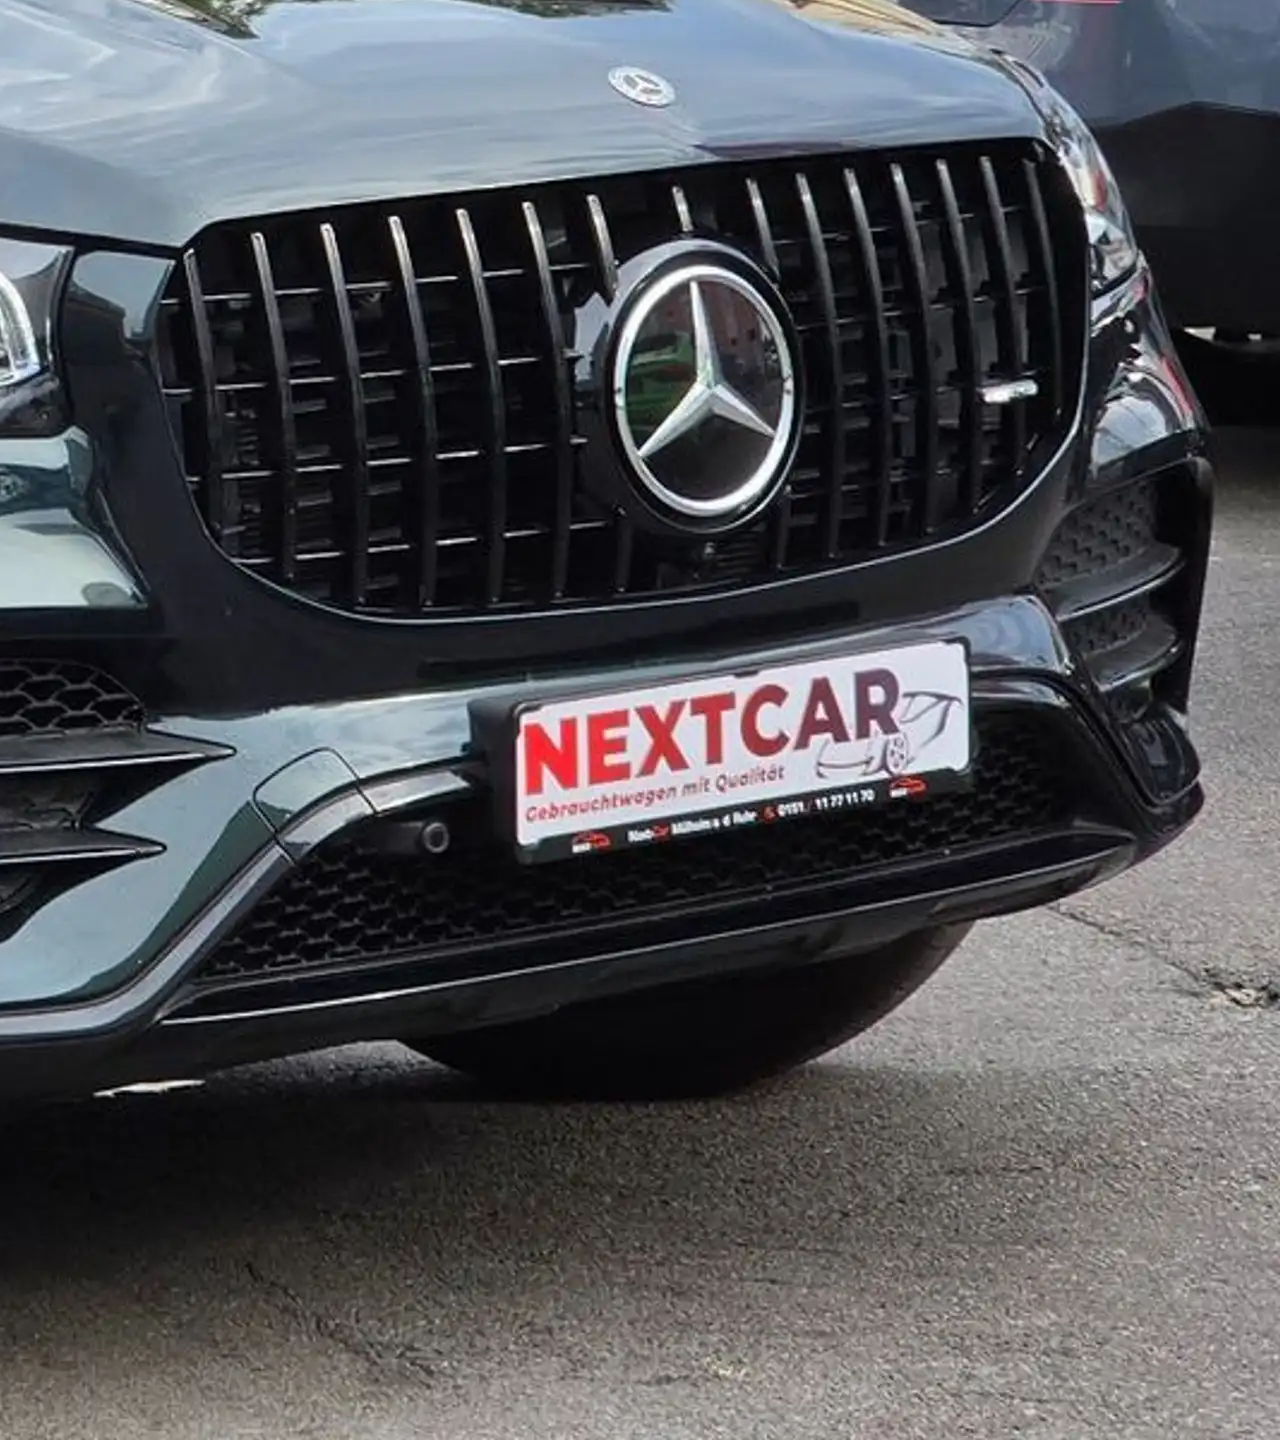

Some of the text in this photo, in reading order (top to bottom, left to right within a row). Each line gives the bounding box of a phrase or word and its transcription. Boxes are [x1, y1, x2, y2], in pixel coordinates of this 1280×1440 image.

[523, 667, 900, 796] NEXTCAR
[525, 785, 678, 822] Gebrauchtwagen
[681, 775, 710, 796] mit
